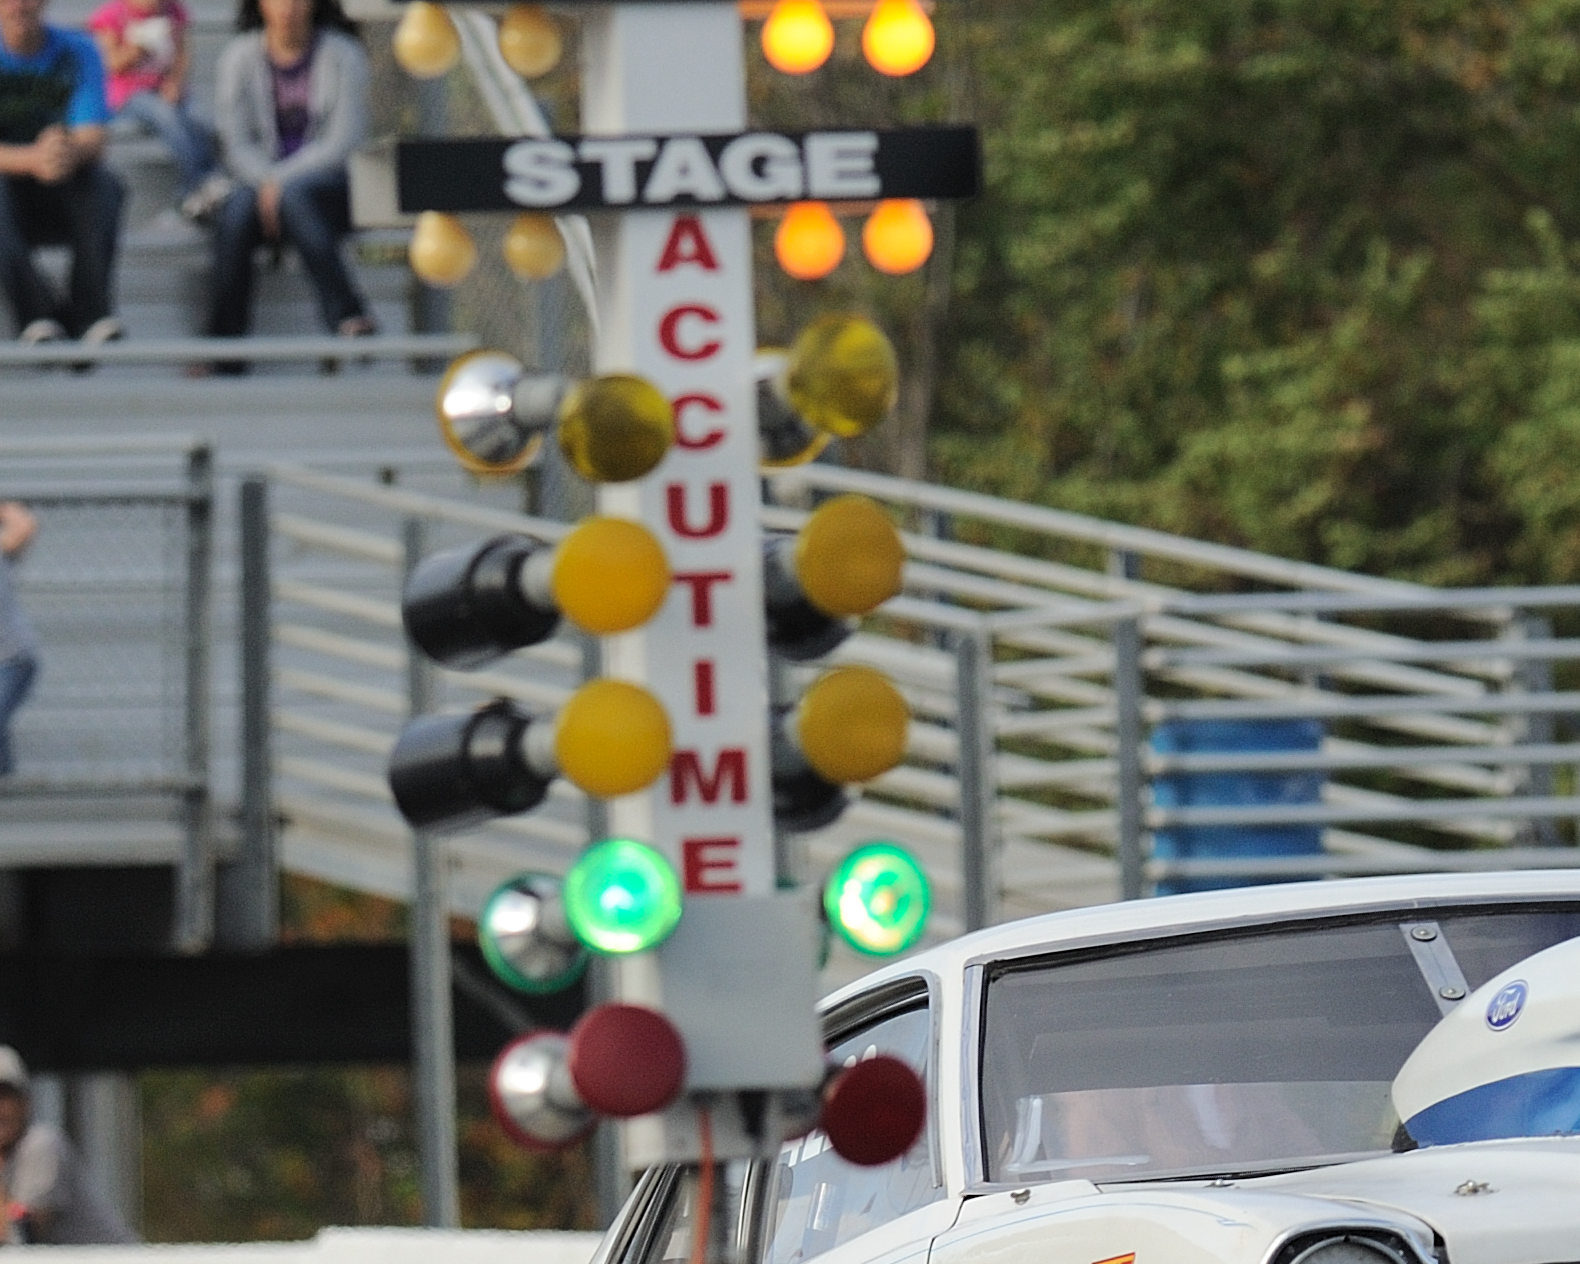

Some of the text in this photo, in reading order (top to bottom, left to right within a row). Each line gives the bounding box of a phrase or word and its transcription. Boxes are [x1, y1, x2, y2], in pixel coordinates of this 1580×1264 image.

[503, 131, 881, 206] STAGE
[655, 215, 749, 894] ACCUTIME
[1491, 987, 1521, 1024] Ford
